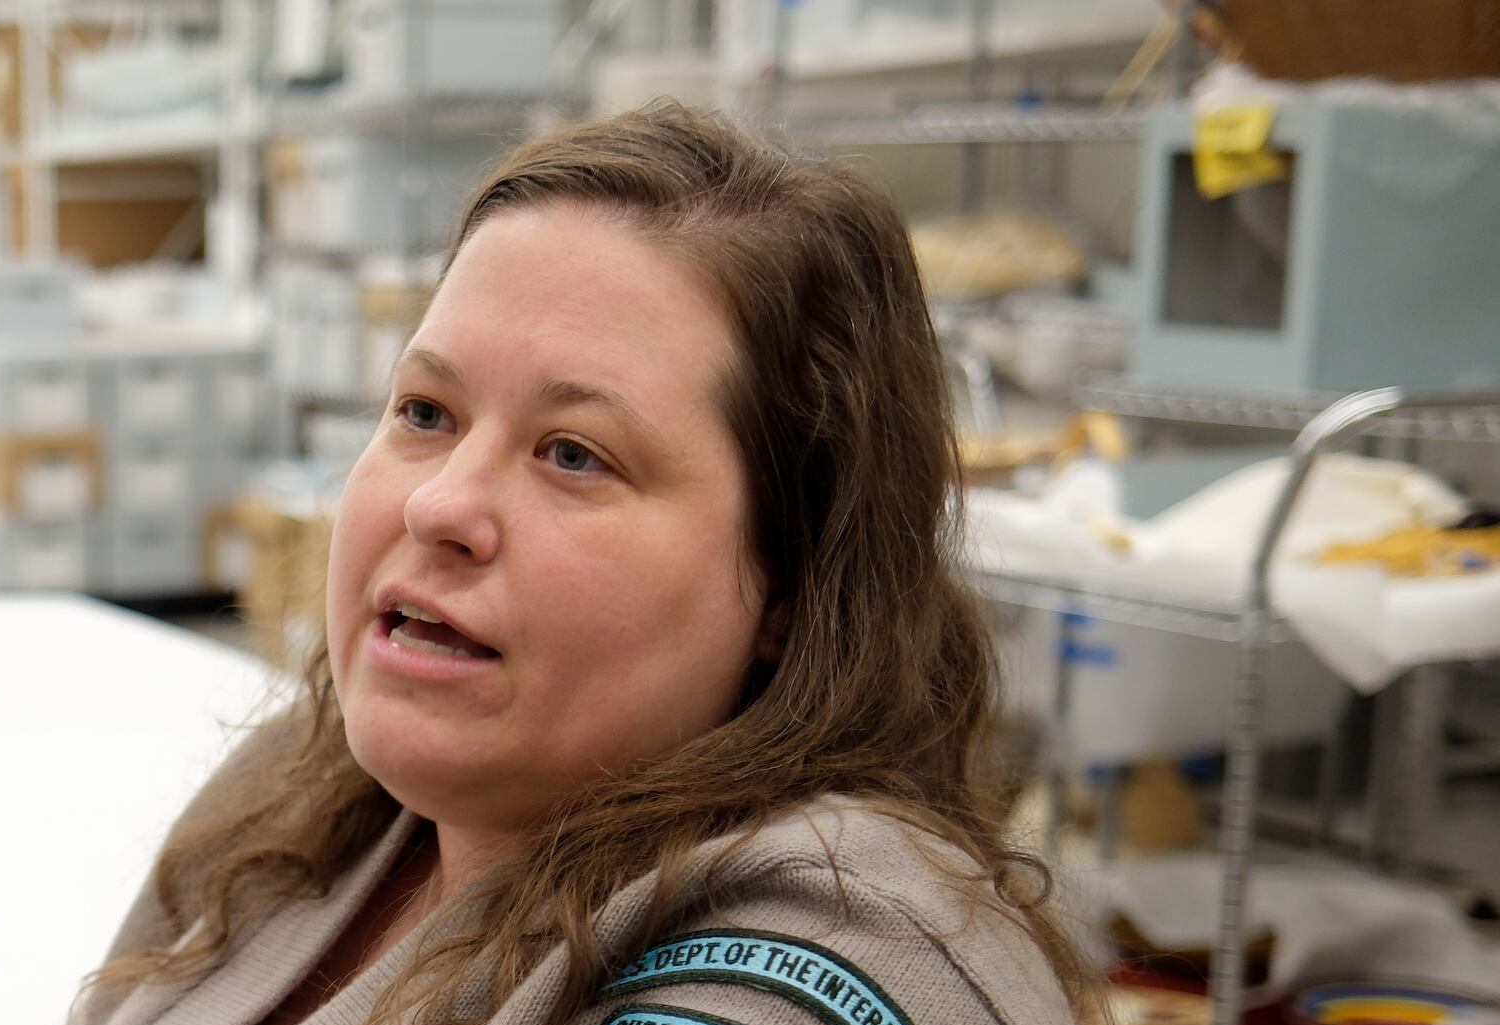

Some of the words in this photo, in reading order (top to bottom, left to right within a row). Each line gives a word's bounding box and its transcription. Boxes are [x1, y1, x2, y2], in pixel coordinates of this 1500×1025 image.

[654, 942, 721, 971] DEPT.
[724, 942, 761, 966] OF
[764, 947, 819, 985] THE
